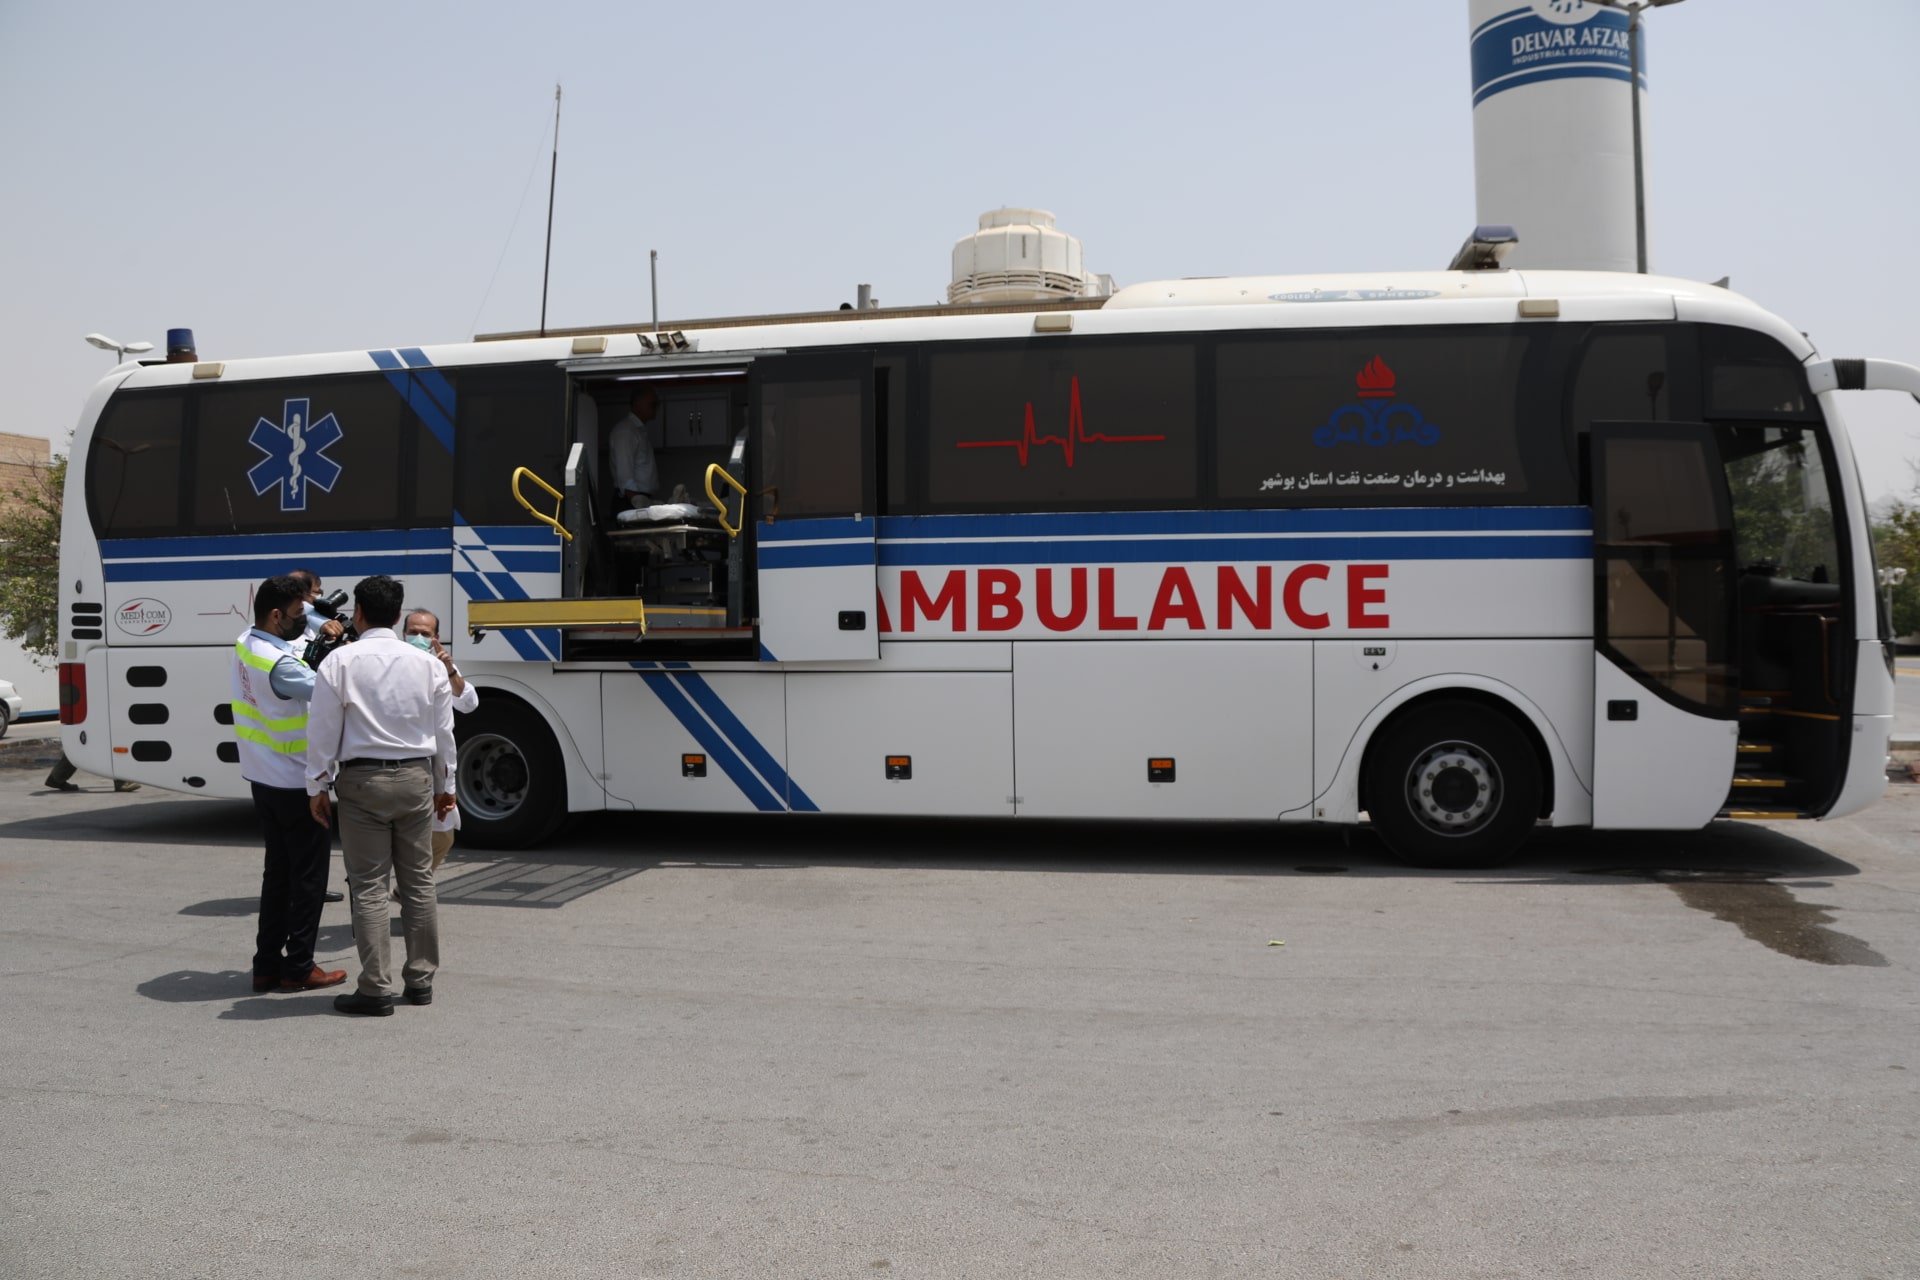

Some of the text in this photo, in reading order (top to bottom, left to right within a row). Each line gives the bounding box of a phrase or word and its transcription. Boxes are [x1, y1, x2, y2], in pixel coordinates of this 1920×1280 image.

[1511, 27, 1629, 56] DELVAR AFZAR
[1512, 49, 1567, 65] INDUSTRIAL
[1568, 47, 1617, 57] EQUIPMENT
[1259, 468, 1506, 490] بهداشت و درمان صنعت نفت استان بوشهر
[877, 563, 1390, 632] MBULANCE
